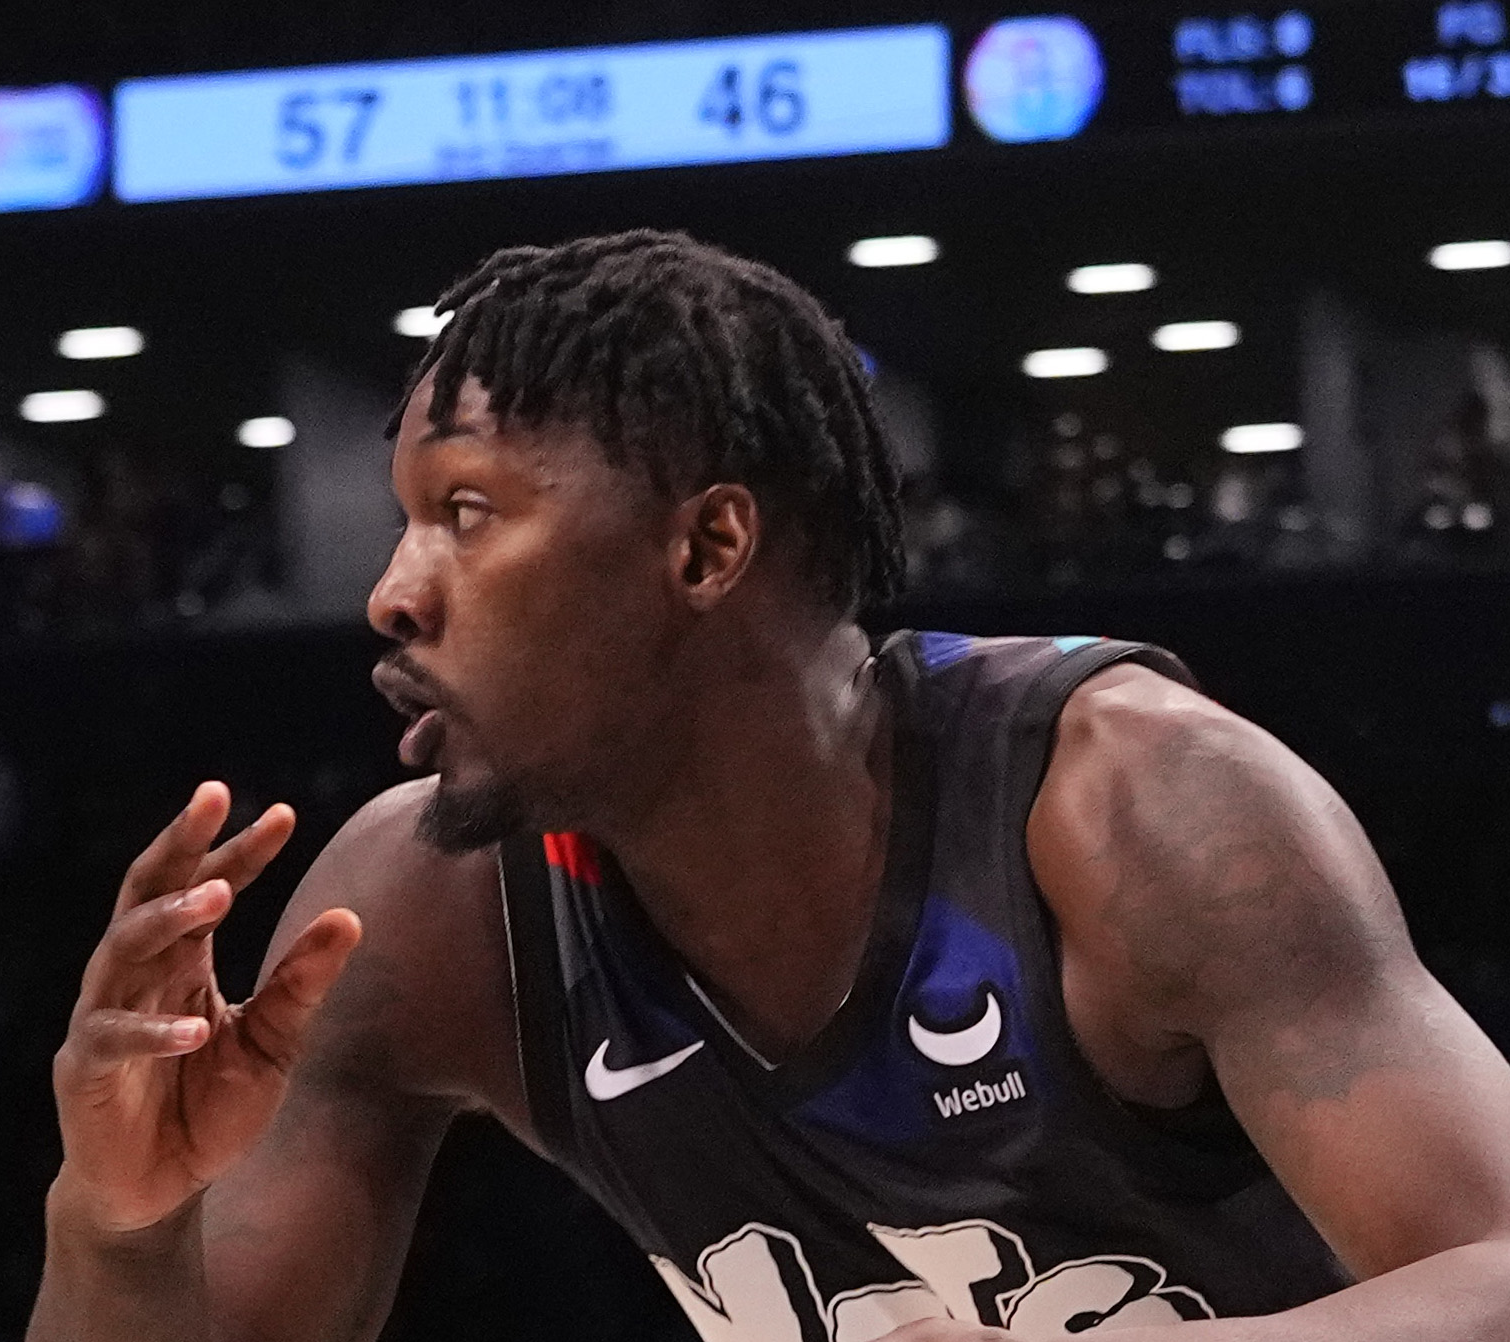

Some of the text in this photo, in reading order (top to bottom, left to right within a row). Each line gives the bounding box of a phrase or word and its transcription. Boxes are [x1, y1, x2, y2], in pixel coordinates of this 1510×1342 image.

[274, 92, 378, 170] 57
[698, 58, 806, 137] 46
[933, 1070, 1027, 1119] Webull
